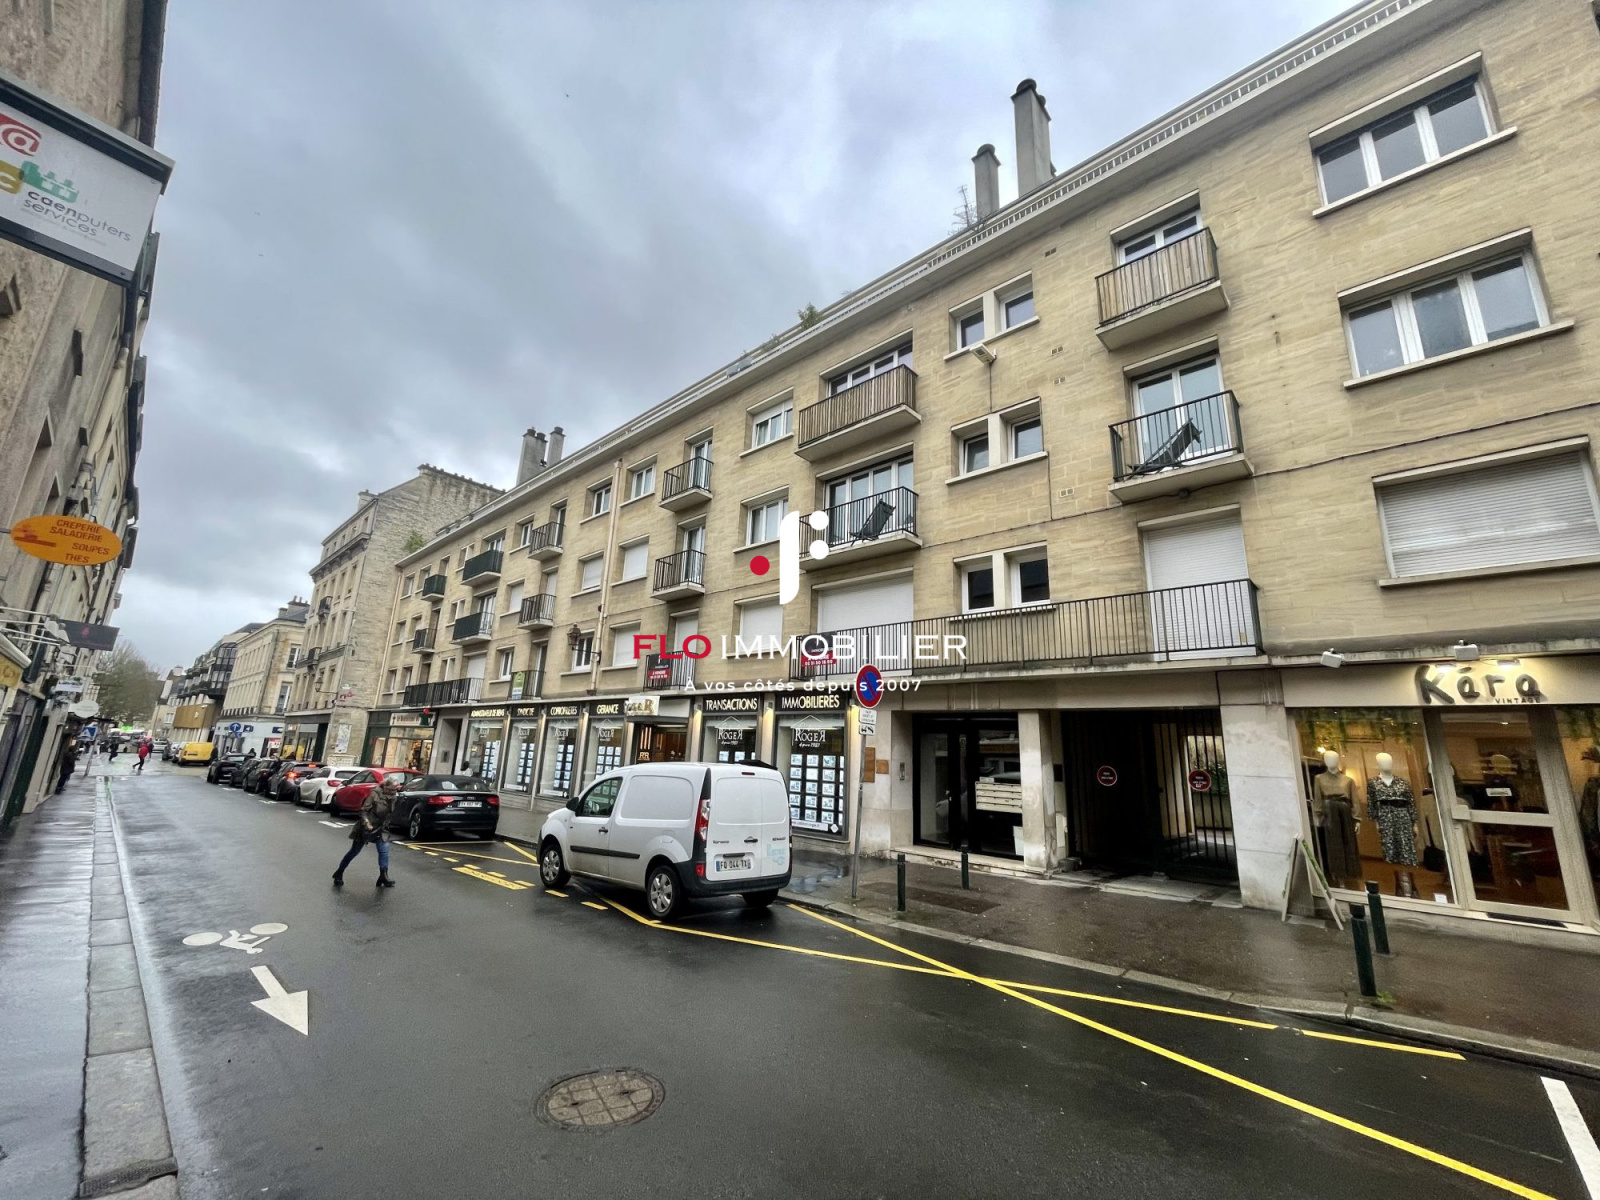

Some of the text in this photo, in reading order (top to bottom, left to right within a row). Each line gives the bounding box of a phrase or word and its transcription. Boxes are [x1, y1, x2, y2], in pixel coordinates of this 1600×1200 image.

[23, 198, 97, 237] services
[27, 190, 131, 242] caenputers
[49, 526, 103, 542] SALADERIE
[56, 519, 101, 534] CREPERIE
[72, 542, 110, 555] SOUPES
[64, 553, 90, 564] THES
[705, 698, 759, 711] TRANSACTIONS
[781, 694, 840, 709] IMMOBILIERES
